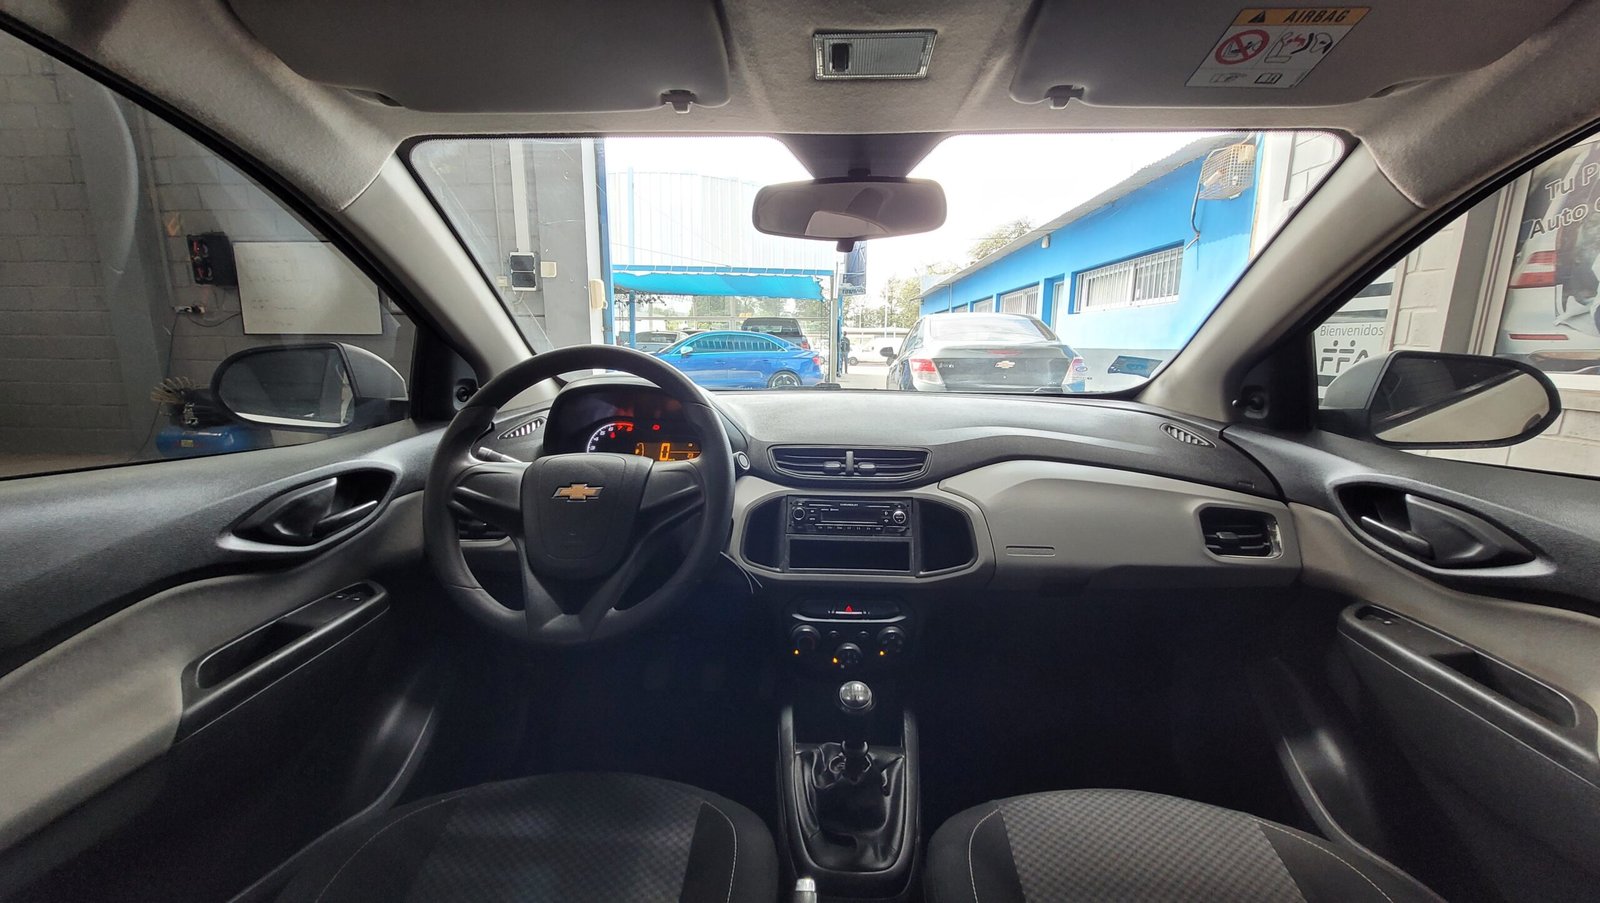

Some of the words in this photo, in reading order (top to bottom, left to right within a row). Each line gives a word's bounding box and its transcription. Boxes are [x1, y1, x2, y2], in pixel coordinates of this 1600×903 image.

[1283, 10, 1351, 23] AIRBAG
[1545, 177, 1575, 200] Tu
[1581, 162, 1600, 186] P
[1529, 204, 1588, 240] Auto
[1320, 324, 1384, 336] Bienvenidos
